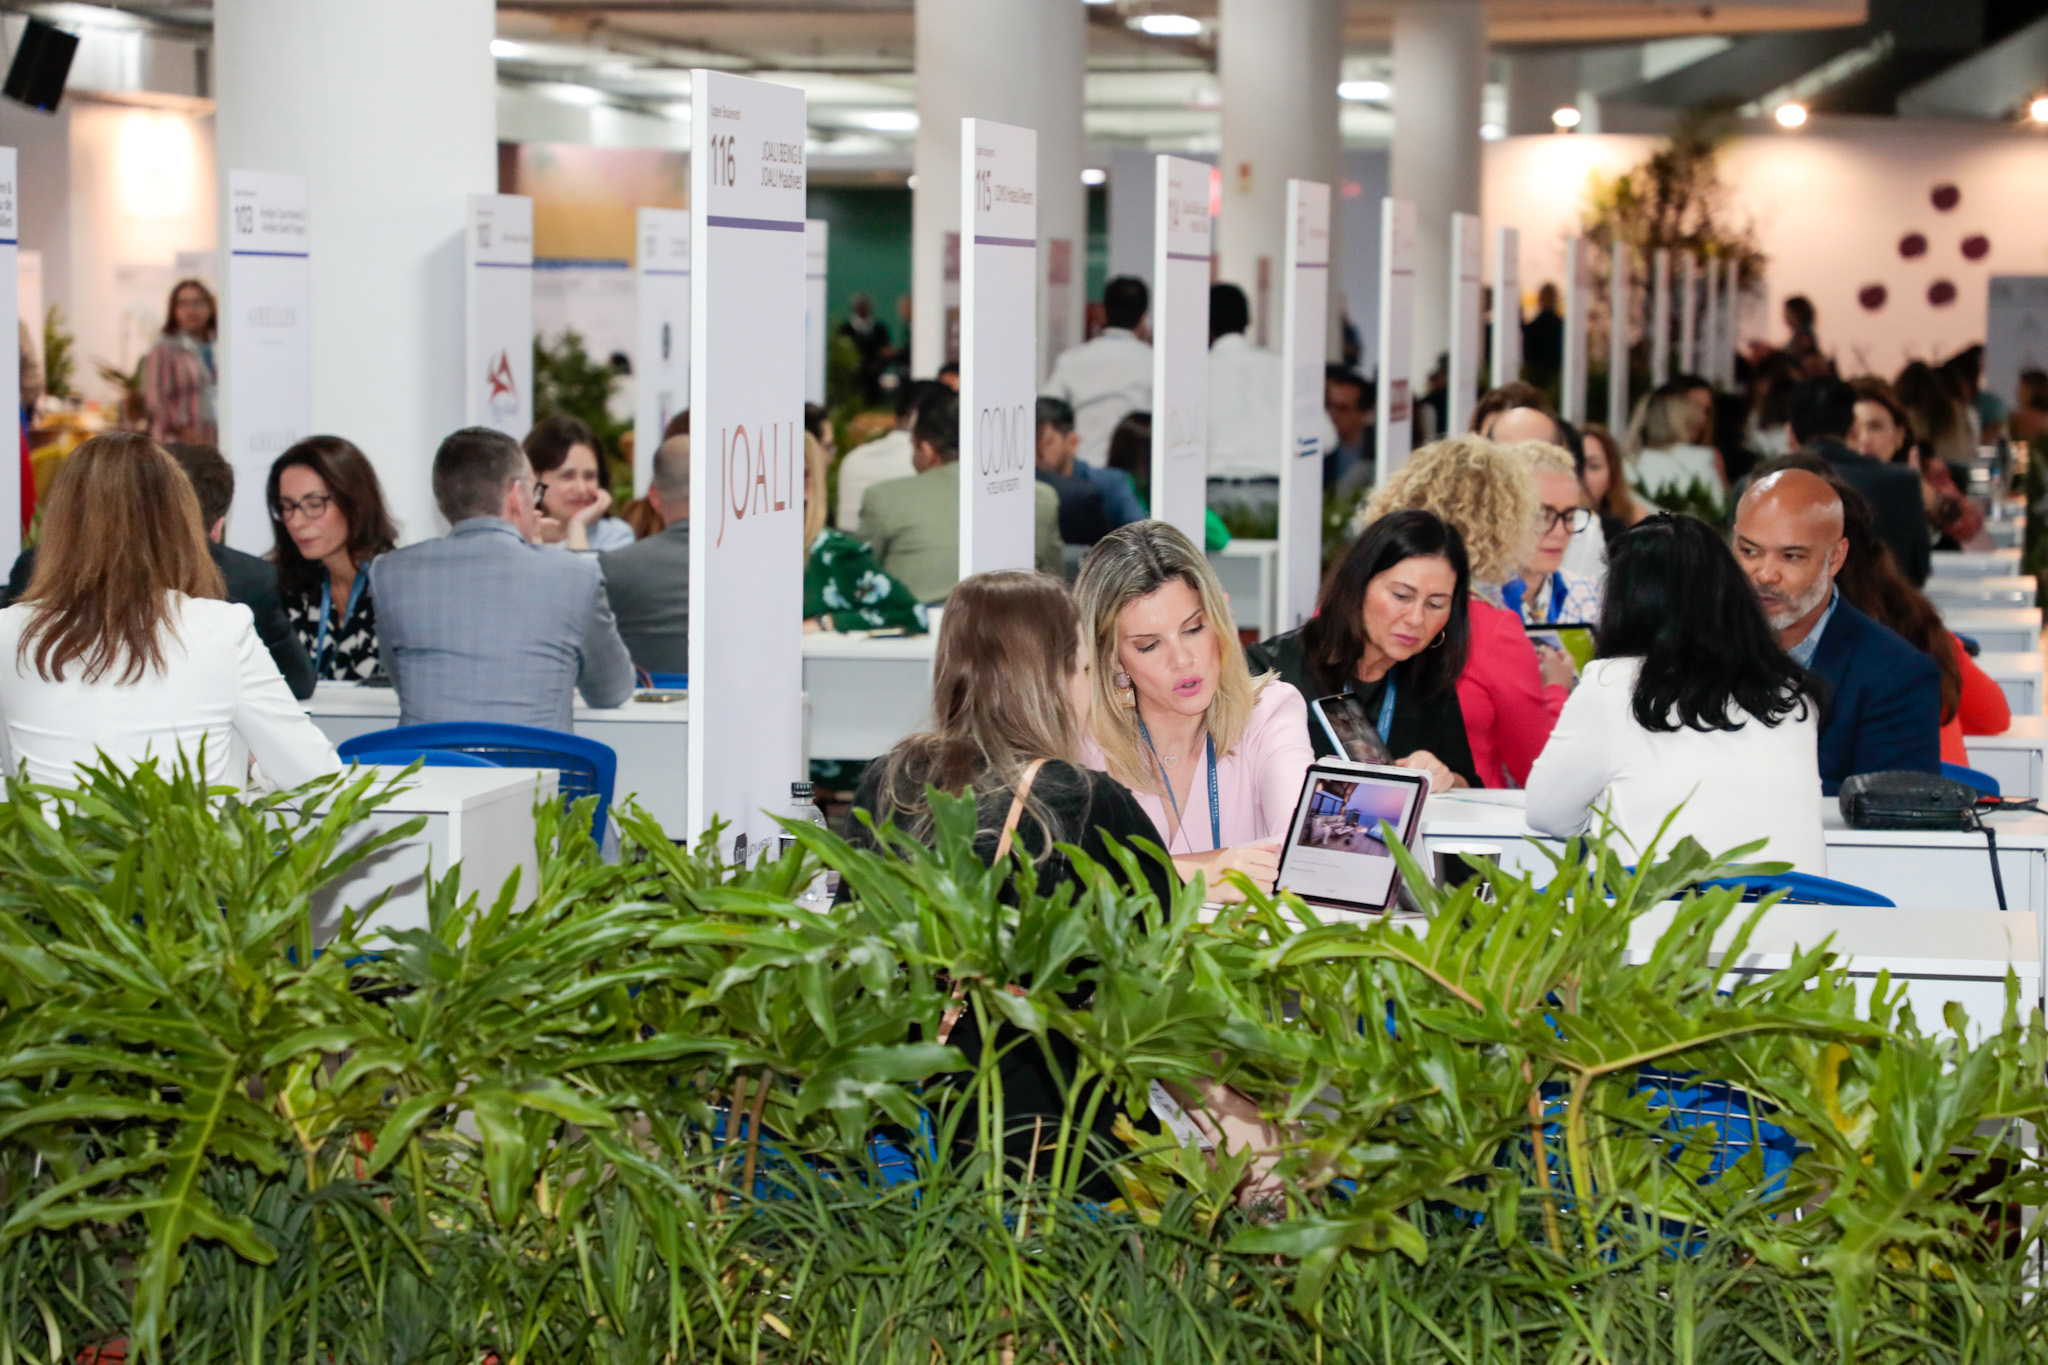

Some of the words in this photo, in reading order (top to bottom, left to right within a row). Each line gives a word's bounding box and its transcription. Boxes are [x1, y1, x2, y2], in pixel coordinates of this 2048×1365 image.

[711, 134, 735, 188] 116
[761, 141, 778, 162] JOALI
[779, 143, 797, 164] BEING
[761, 167, 778, 188] JOALI
[779, 168, 802, 190] Maldives
[977, 169, 991, 212] 115
[234, 205, 253, 234] 103
[981, 404, 1026, 476] COMO
[717, 422, 793, 549] JOALI
